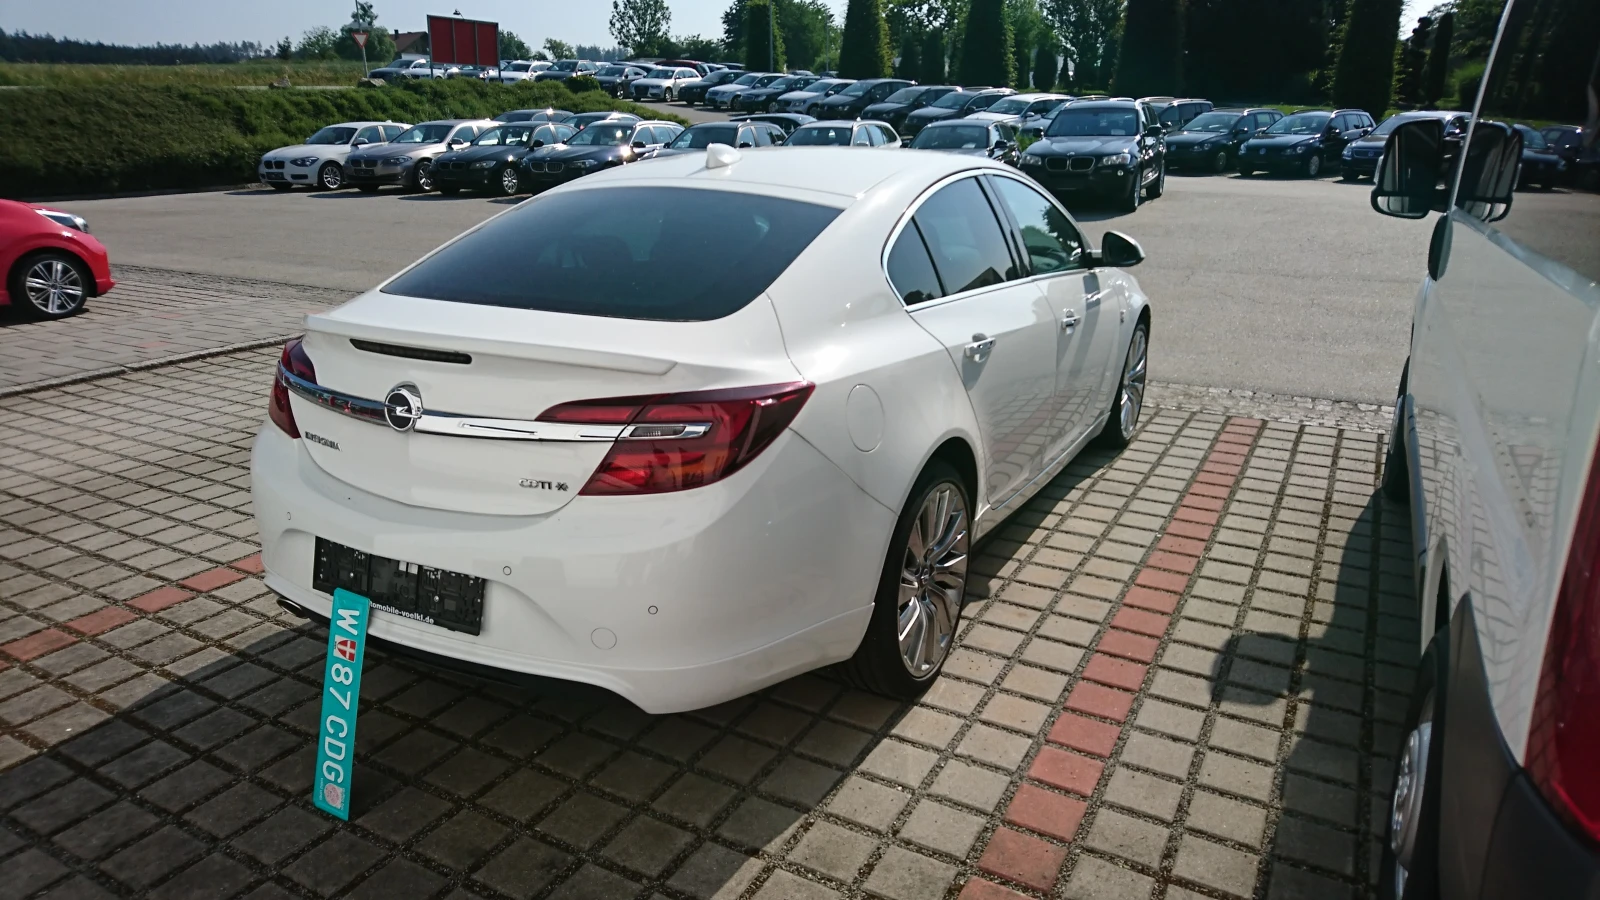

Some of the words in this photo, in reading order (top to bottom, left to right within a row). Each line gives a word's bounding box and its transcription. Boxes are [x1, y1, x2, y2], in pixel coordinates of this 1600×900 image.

[518, 477, 553, 490] CDTI
[336, 608, 360, 636] W
[368, 600, 435, 626] tomobile-voelkl.de
[329, 662, 353, 711] 87
[322, 714, 348, 784] CDG
